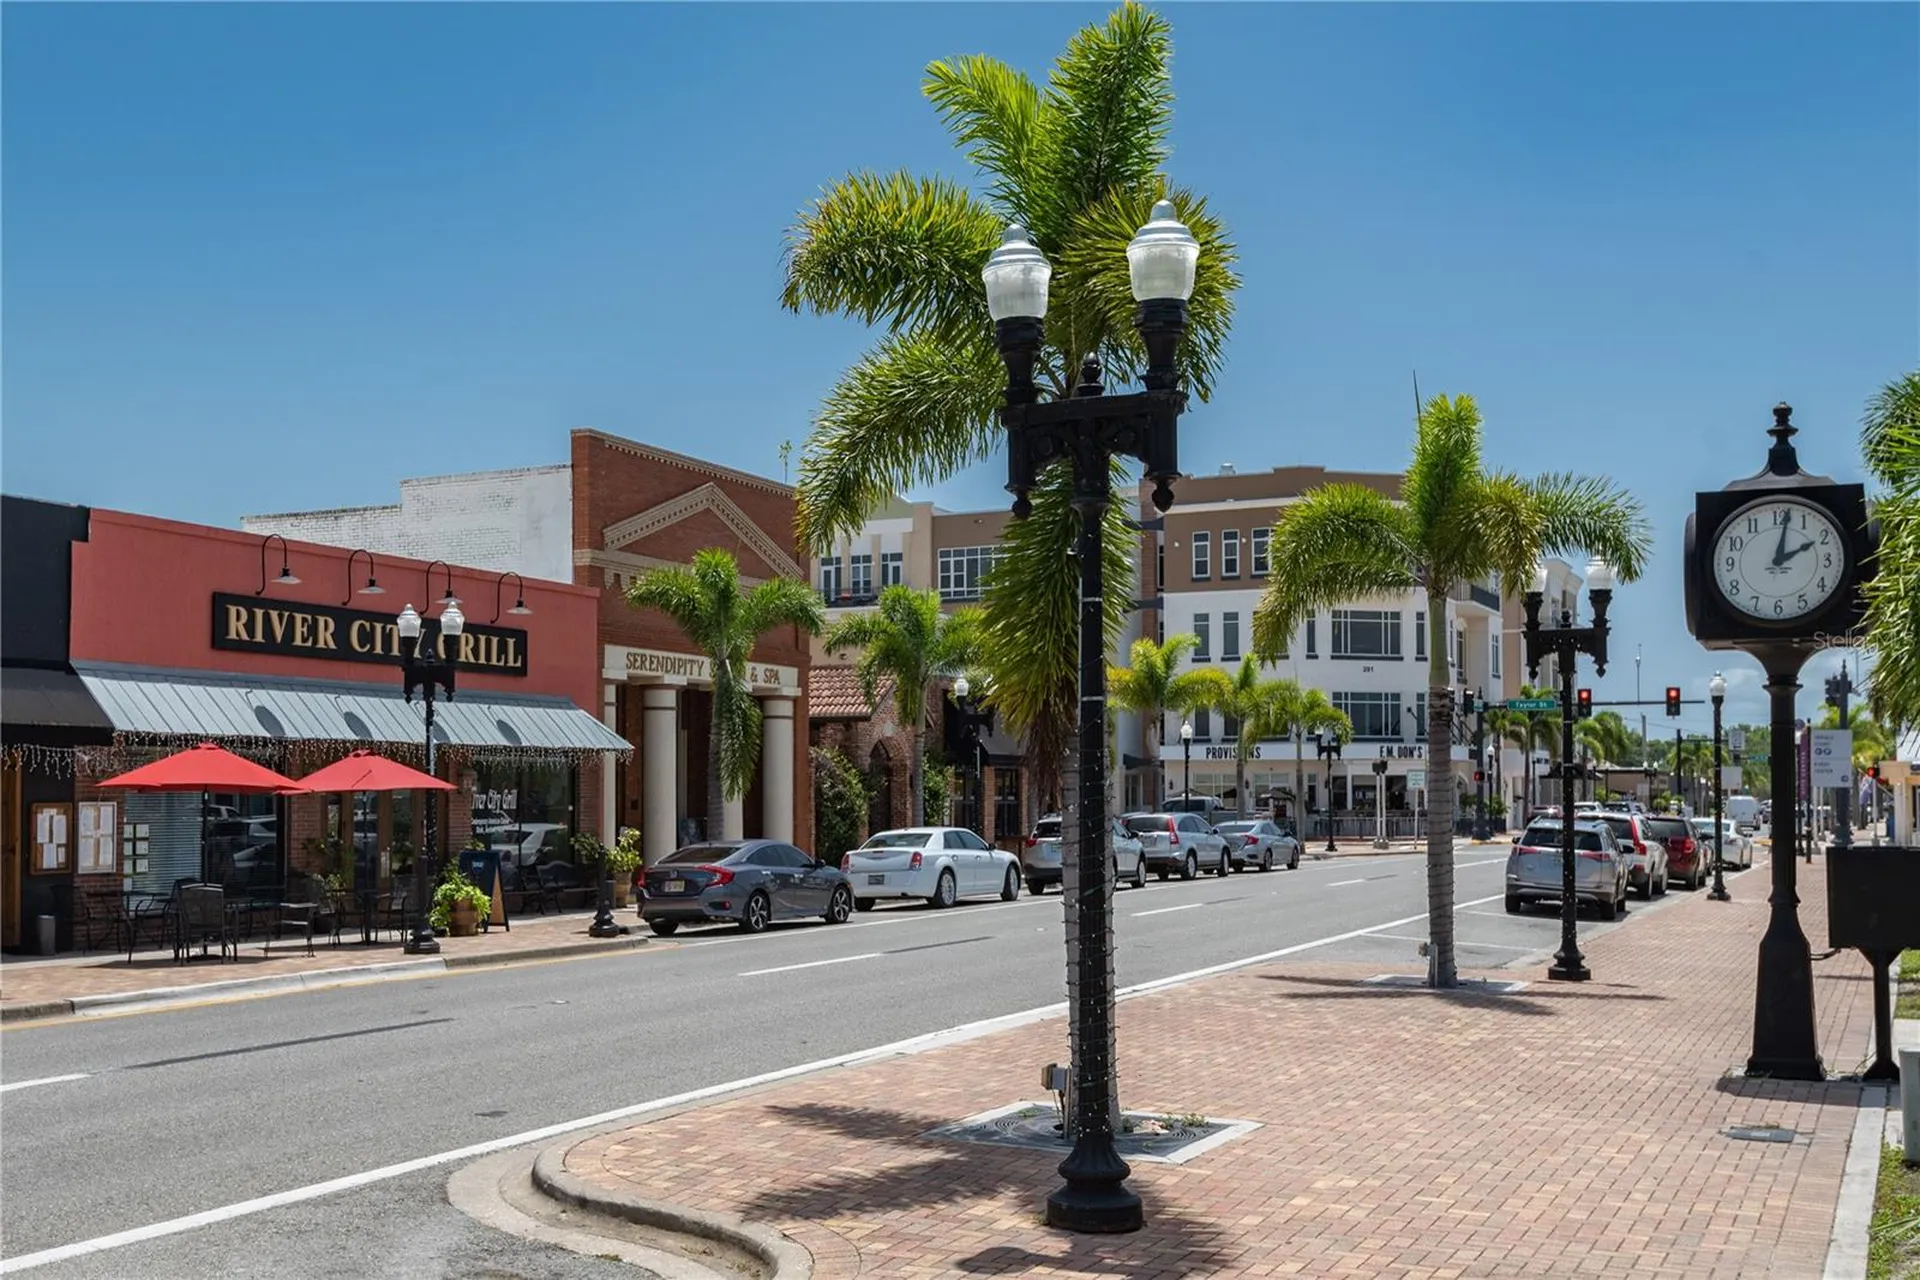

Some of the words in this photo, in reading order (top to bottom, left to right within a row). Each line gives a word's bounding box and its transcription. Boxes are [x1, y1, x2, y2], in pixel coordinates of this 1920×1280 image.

[1747, 518, 1758, 533] 11
[1801, 514, 1807, 530] 1
[1729, 536, 1743, 552] 10
[1820, 529, 1829, 545] 2
[1726, 557, 1735, 573] 9
[1823, 552, 1832, 569] 3
[1729, 579, 1740, 596] 8
[1817, 576, 1827, 593] 4
[1750, 595, 1760, 612] 7
[1774, 599, 1784, 616] 6
[1797, 592, 1808, 610] 5
[225, 604, 338, 649] RIVER
[625, 652, 705, 677] SERENDIPITY
[750, 666, 759, 683] &
[763, 667, 781, 685] SPA
[1205, 746, 1261, 759] PROVISNS
